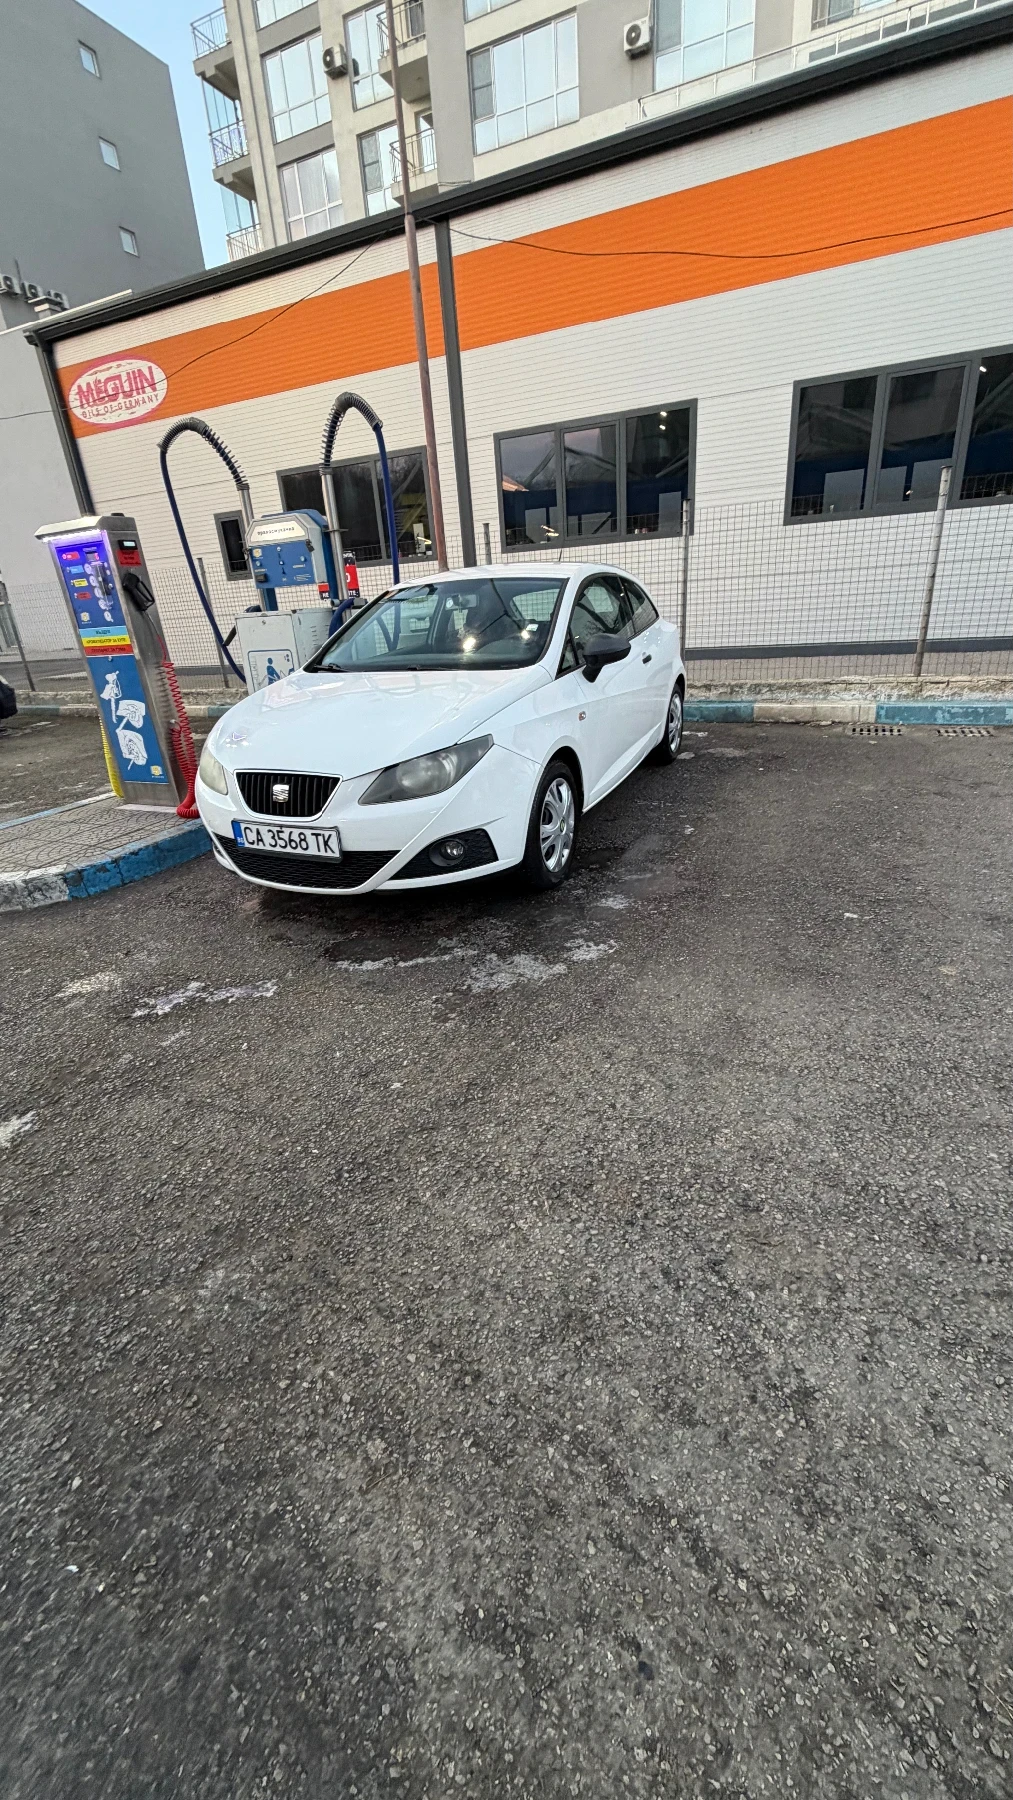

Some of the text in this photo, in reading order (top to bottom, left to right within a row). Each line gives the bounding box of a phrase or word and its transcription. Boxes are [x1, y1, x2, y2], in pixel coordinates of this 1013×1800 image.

[103, 404, 115, 414] OF
[118, 393, 159, 411] GERMANY
[243, 826, 335, 854] CA 3568 TK
